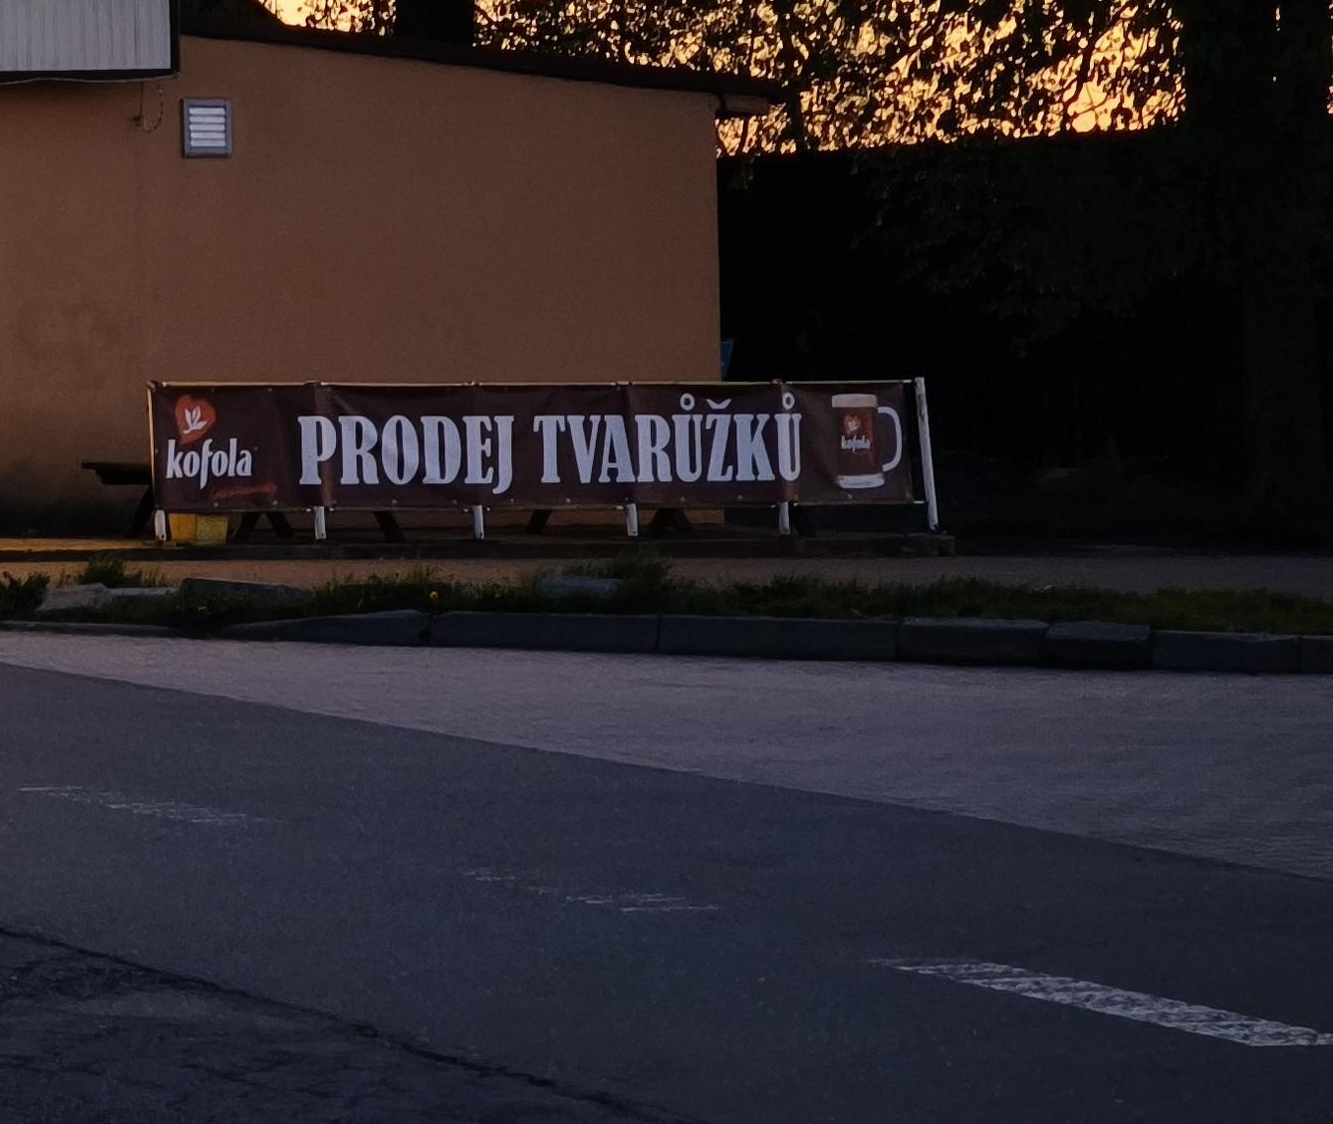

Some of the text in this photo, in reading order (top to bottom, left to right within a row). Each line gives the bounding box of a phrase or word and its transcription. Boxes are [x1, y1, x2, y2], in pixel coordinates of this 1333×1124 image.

[165, 438, 253, 490] kofola
[297, 392, 803, 494] PRODEJ TVARŮŽKŮ
